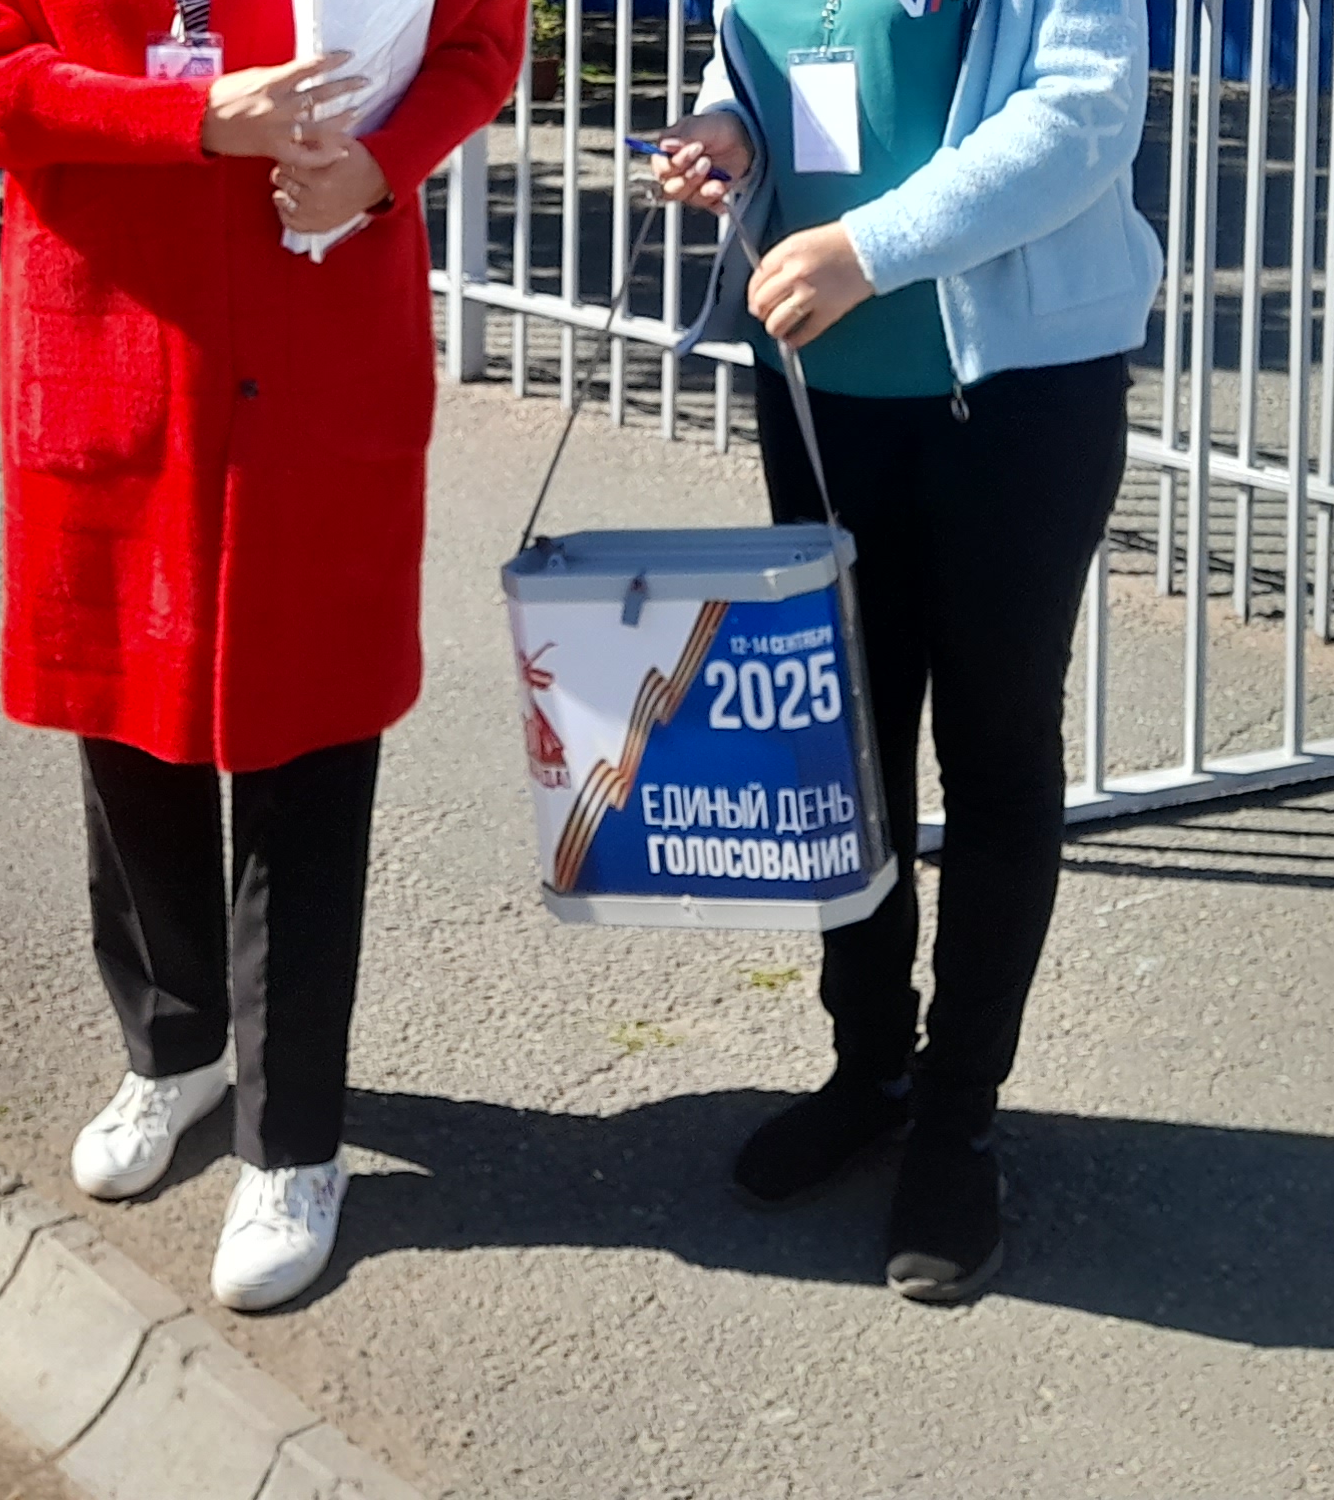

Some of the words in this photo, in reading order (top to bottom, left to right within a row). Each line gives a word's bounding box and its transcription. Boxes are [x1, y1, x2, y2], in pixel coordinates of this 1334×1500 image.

[704, 650, 842, 731] 2025
[640, 782, 769, 831] ЕДИНЫЙ
[775, 781, 855, 835] ДЕНЬ
[646, 831, 861, 882] ГОЛОСОВАНИЯ
